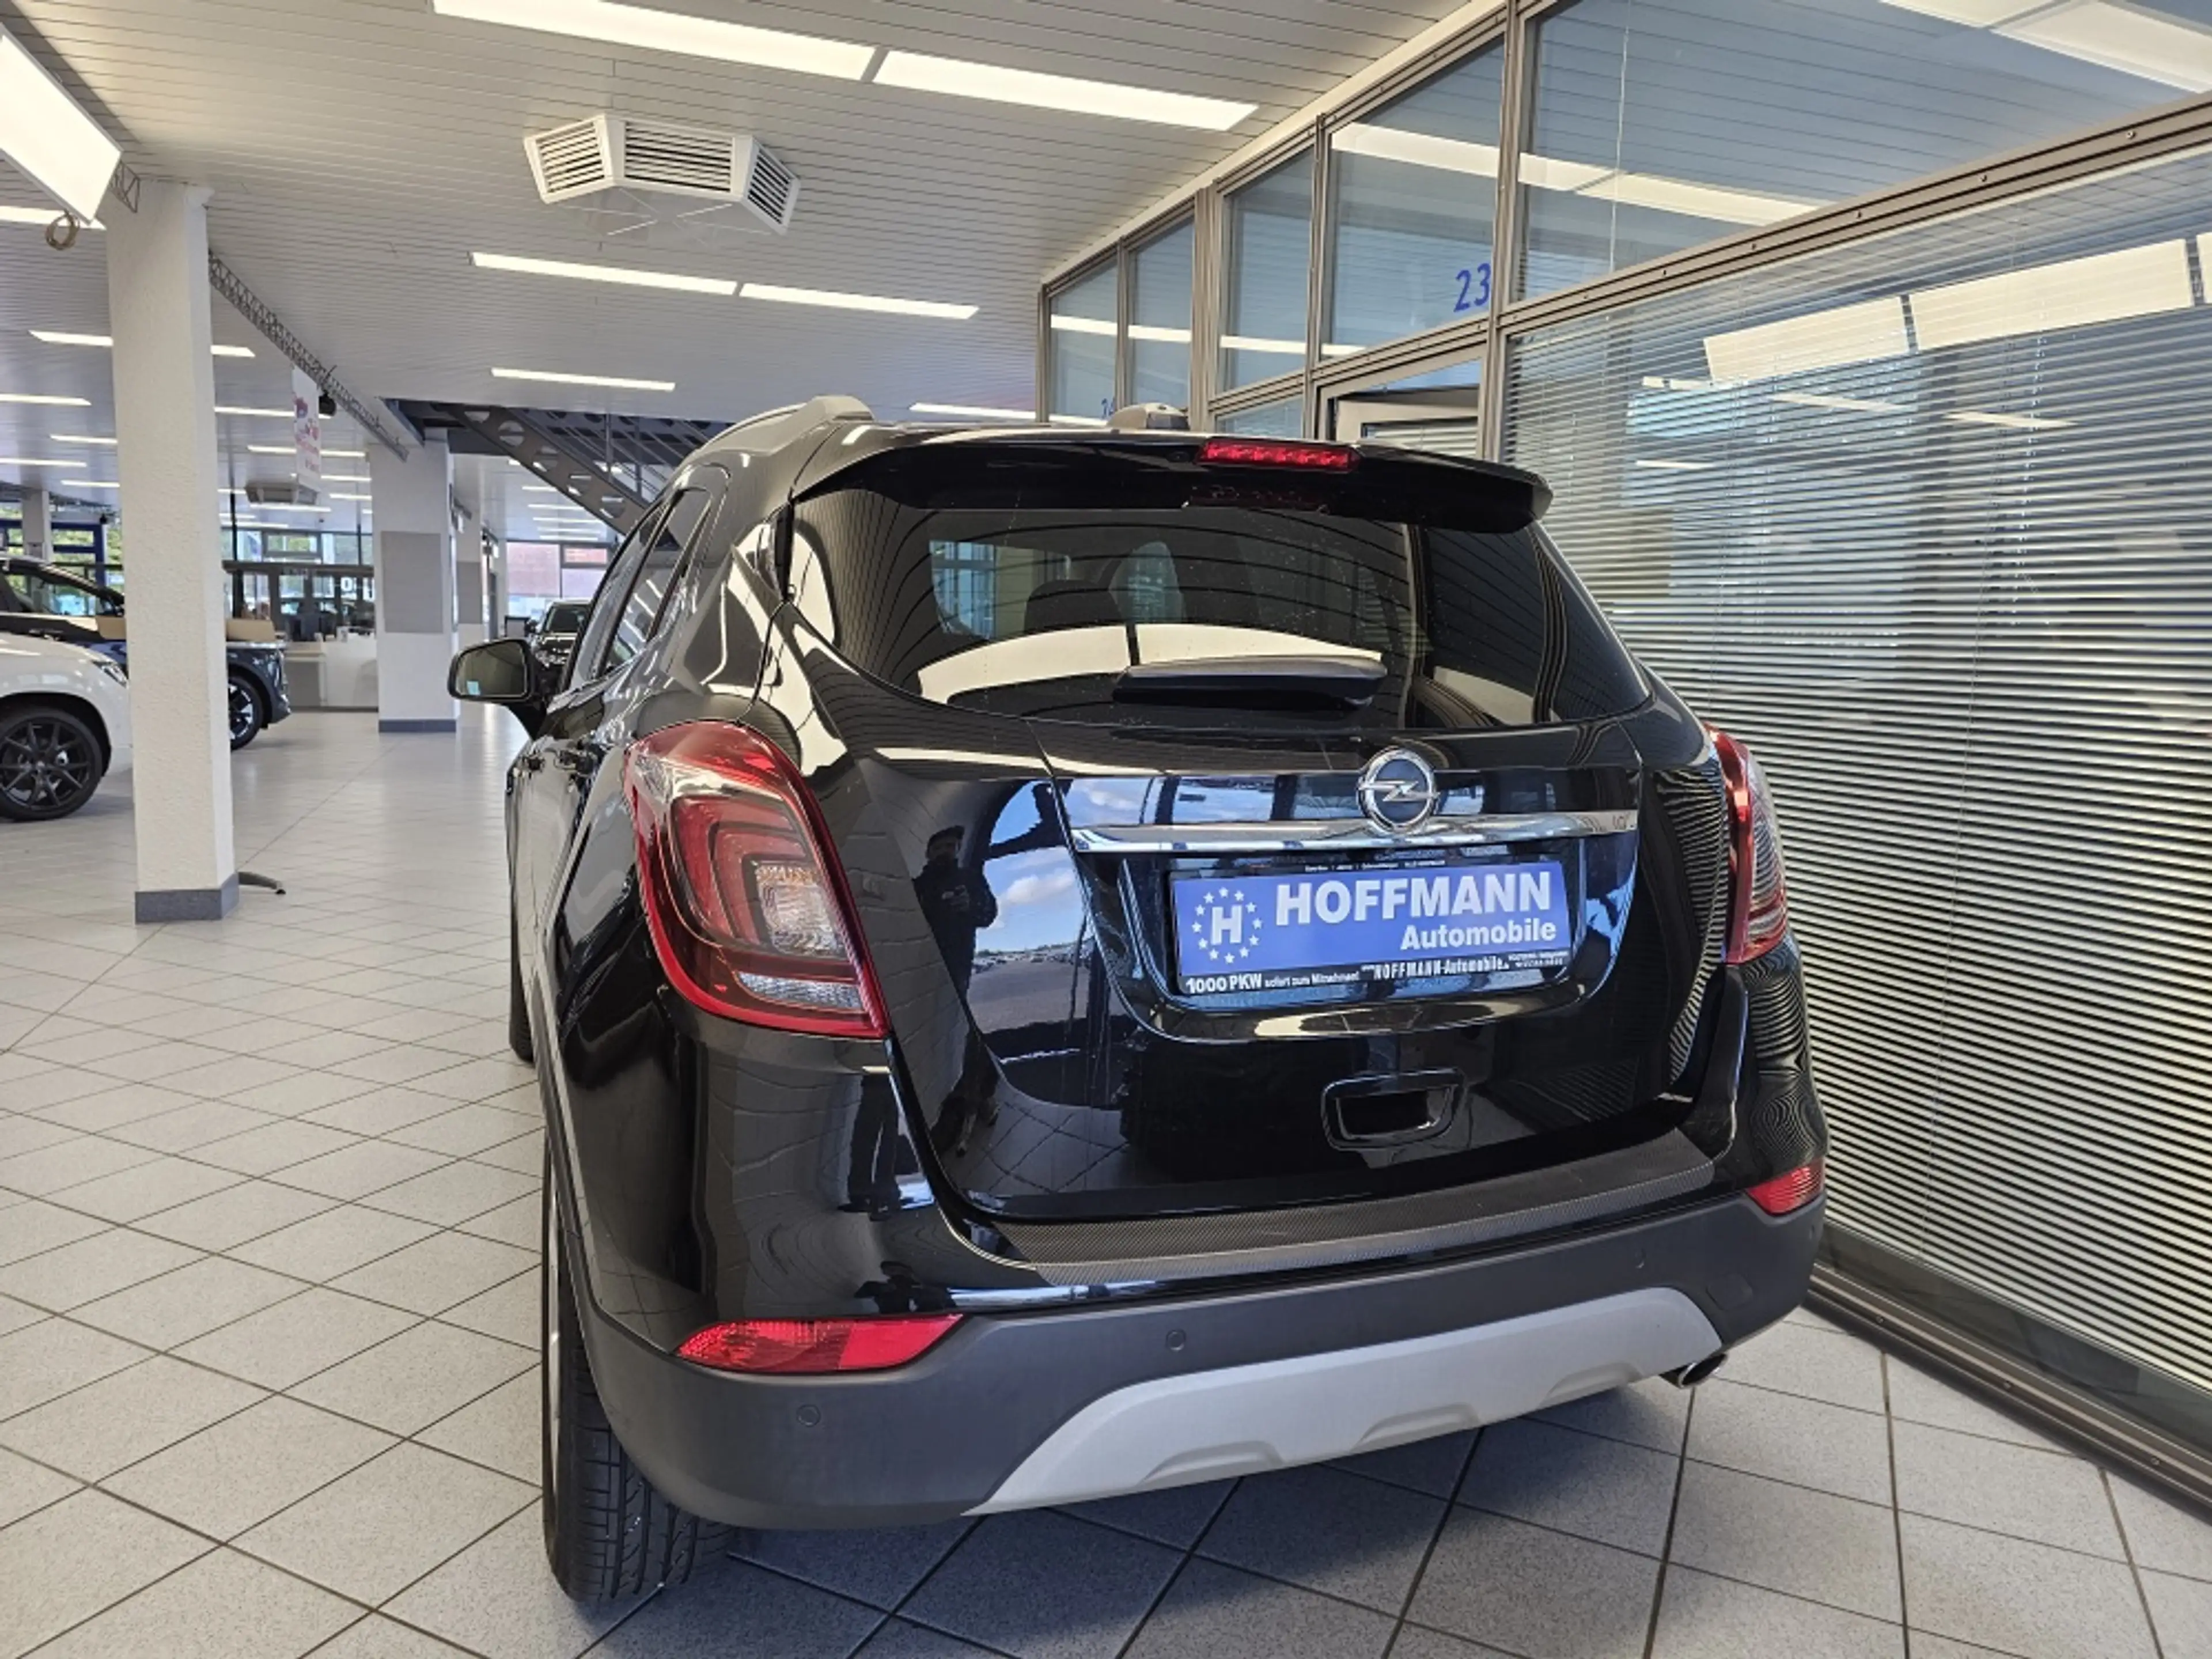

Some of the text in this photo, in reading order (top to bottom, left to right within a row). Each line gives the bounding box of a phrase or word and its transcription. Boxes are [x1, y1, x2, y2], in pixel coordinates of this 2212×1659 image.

[1453, 263, 1491, 312] 23
[1276, 871, 1551, 926] HOFFMANN
[1211, 906, 1243, 945] H
[1400, 917, 1556, 950] Automobile
[1185, 975, 1227, 994] 1000
[1229, 974, 1262, 990] PKW
